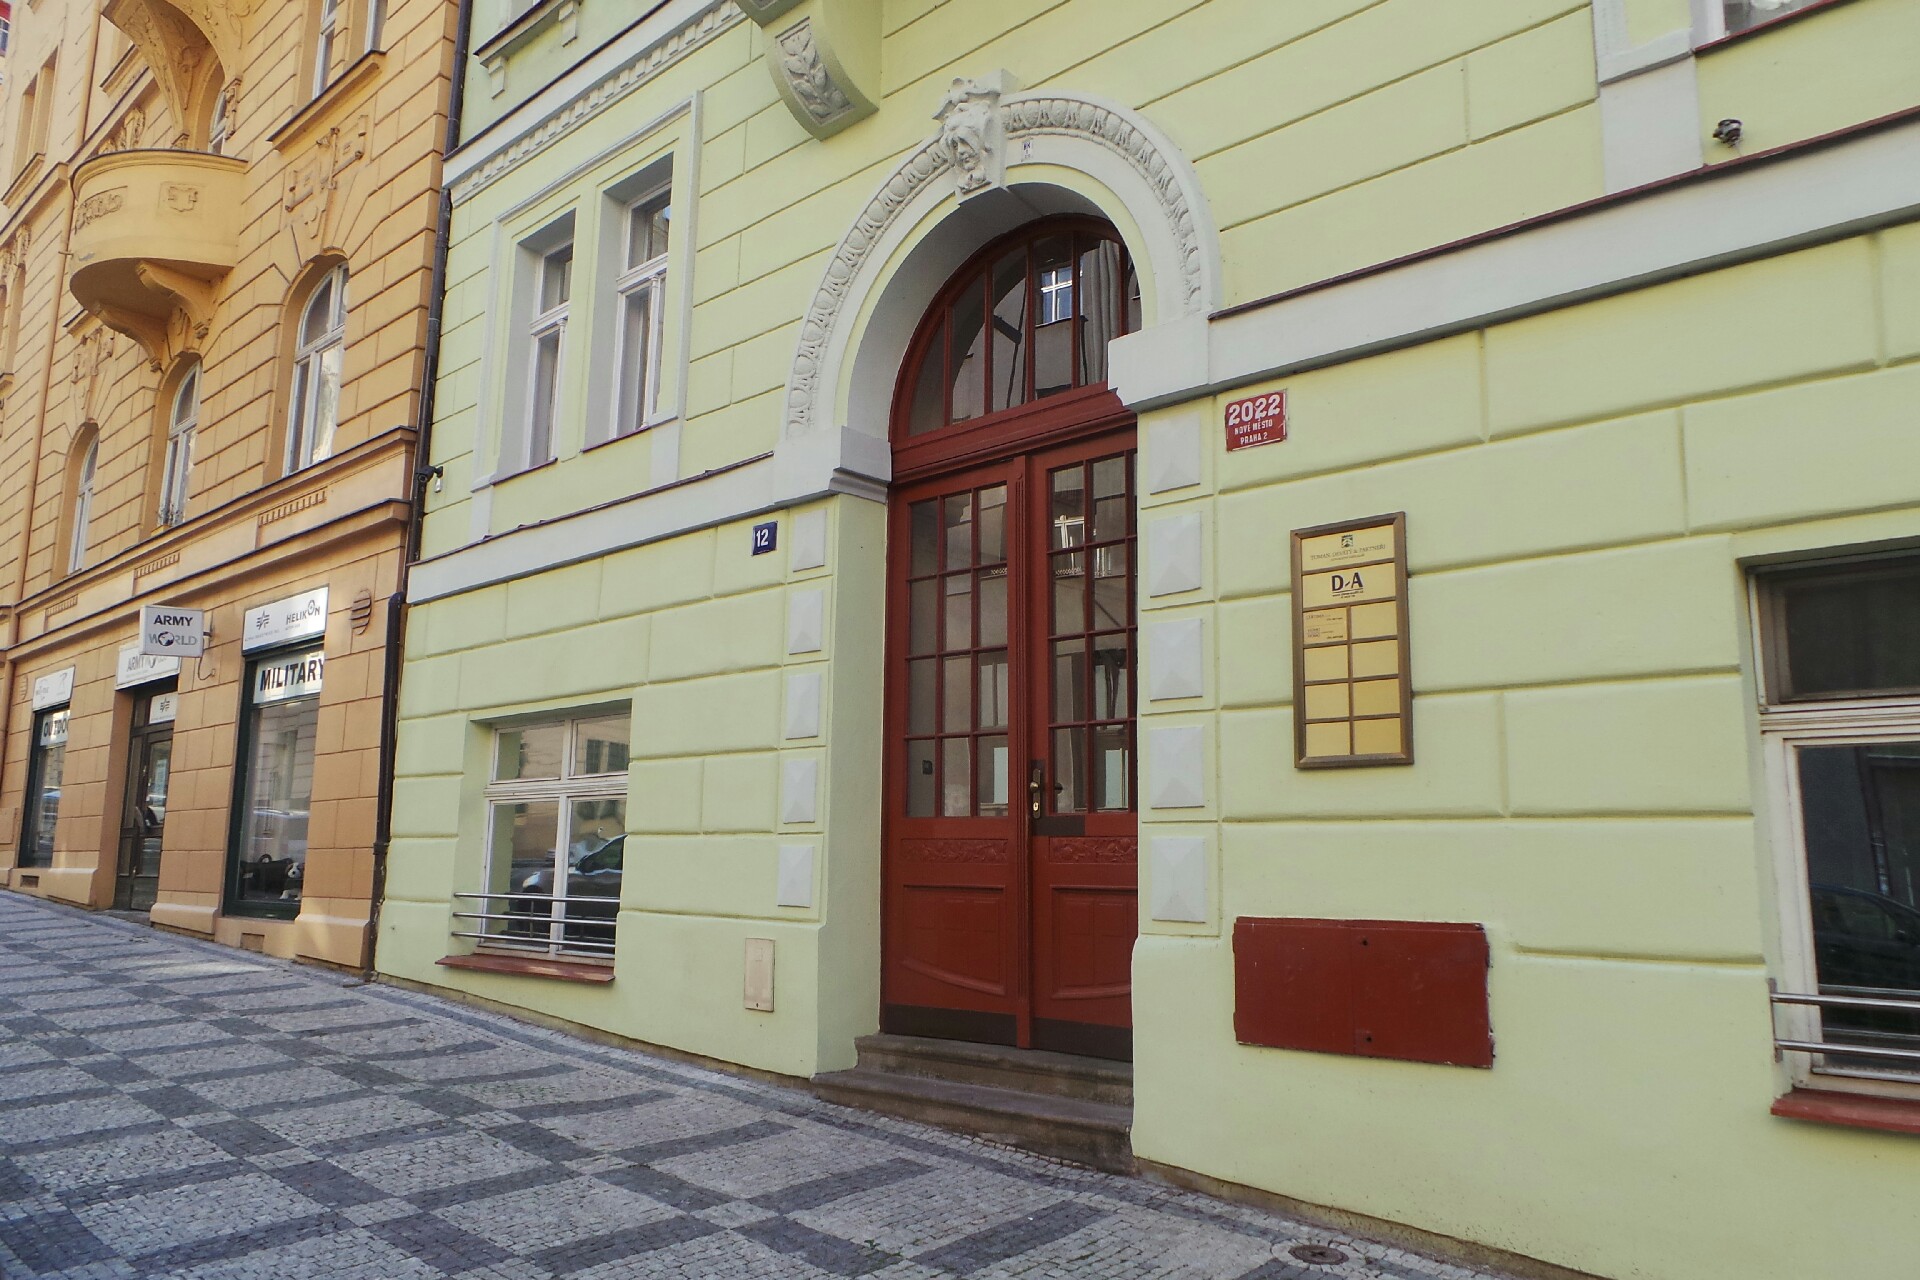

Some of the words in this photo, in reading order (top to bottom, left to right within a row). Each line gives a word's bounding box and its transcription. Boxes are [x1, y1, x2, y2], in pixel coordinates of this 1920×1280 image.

[1228, 394, 1281, 426] 2022
[1234, 422, 1251, 435] NOVÉ
[1252, 418, 1273, 431] MĚSTO
[1240, 432, 1262, 445] PRAHA
[1263, 431, 1268, 440] 2
[756, 528, 769, 548] 12
[153, 614, 193, 626] ARMY
[286, 599, 321, 625] HELIKON
[149, 631, 198, 647] WORLD
[259, 658, 324, 691] MILITARY
[43, 717, 69, 738] OUTDO
